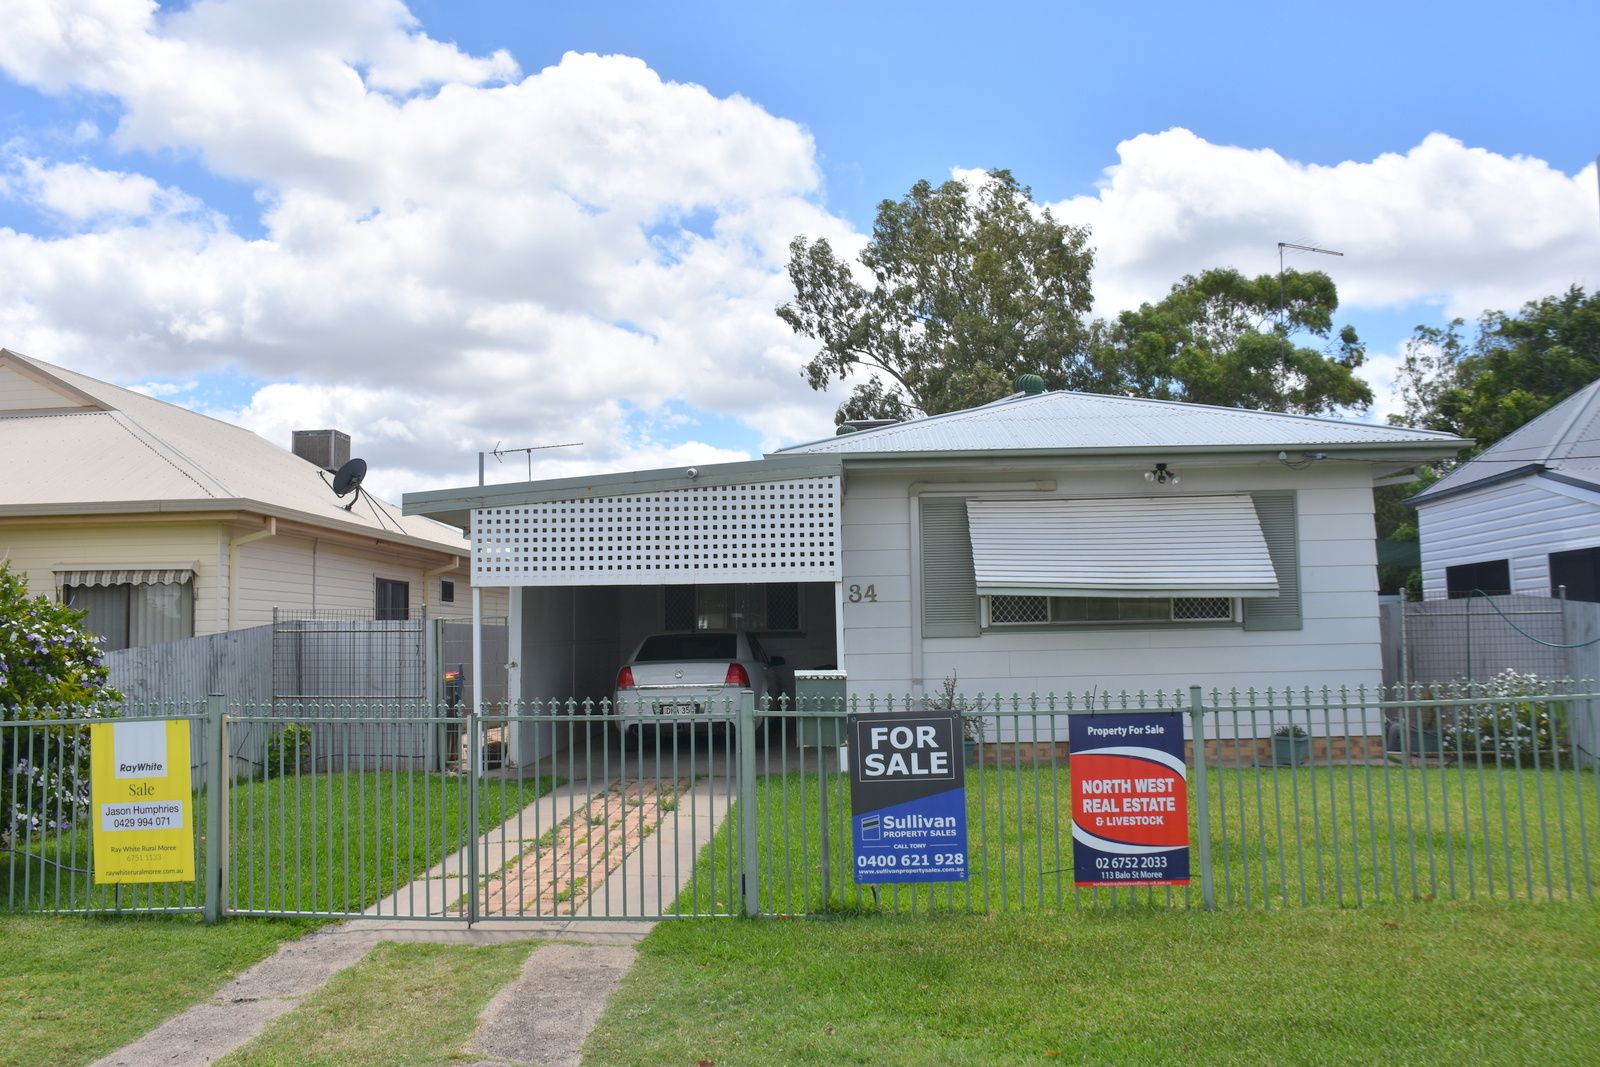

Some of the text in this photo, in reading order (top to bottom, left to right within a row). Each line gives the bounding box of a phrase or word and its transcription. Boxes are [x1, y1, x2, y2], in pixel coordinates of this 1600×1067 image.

[849, 584, 877, 603] 34
[871, 726, 939, 750] FOR
[1088, 725, 1164, 737] Property For Sale
[865, 752, 948, 776] SALE
[128, 782, 155, 797] Sale
[1082, 778, 1174, 794] NORTH WEST
[106, 804, 179, 816] Jason Humphries
[1082, 797, 1176, 813] REAL ESTATE
[114, 817, 170, 828] 0429 994 071
[883, 815, 956, 829] Sullivan
[1096, 816, 1164, 826] & LIVESTOCK
[884, 830, 927, 838] PROPERTY
[858, 853, 964, 867] 0400 621 928
[1096, 856, 1167, 869] 02 6752 2033
[1101, 871, 1114, 879] 113
[1115, 871, 1130, 879] Balo
[1132, 871, 1139, 879] St
